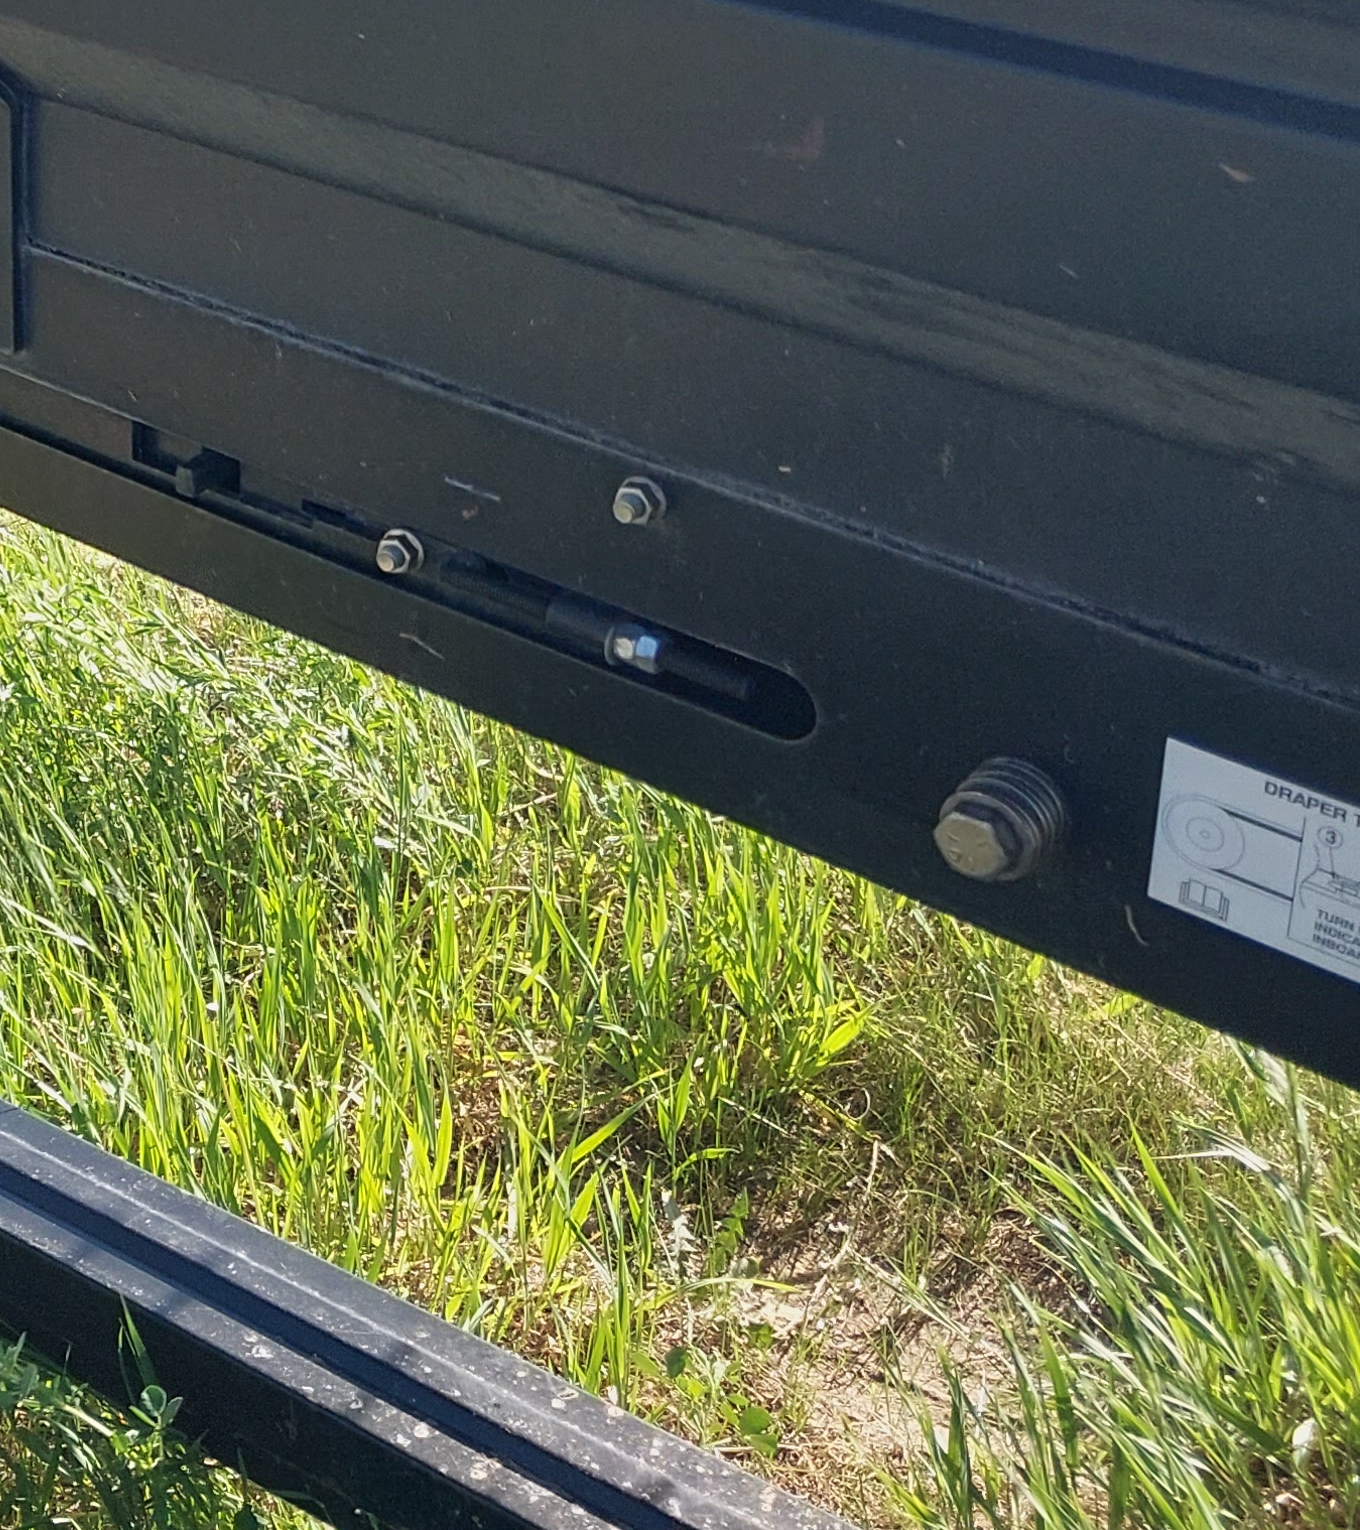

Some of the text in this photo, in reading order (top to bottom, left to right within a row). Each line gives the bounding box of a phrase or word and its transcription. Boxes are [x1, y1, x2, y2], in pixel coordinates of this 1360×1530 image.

[1265, 781, 1347, 823] DRAPER
[1325, 831, 1337, 845] 3
[1318, 910, 1355, 931] TURN
